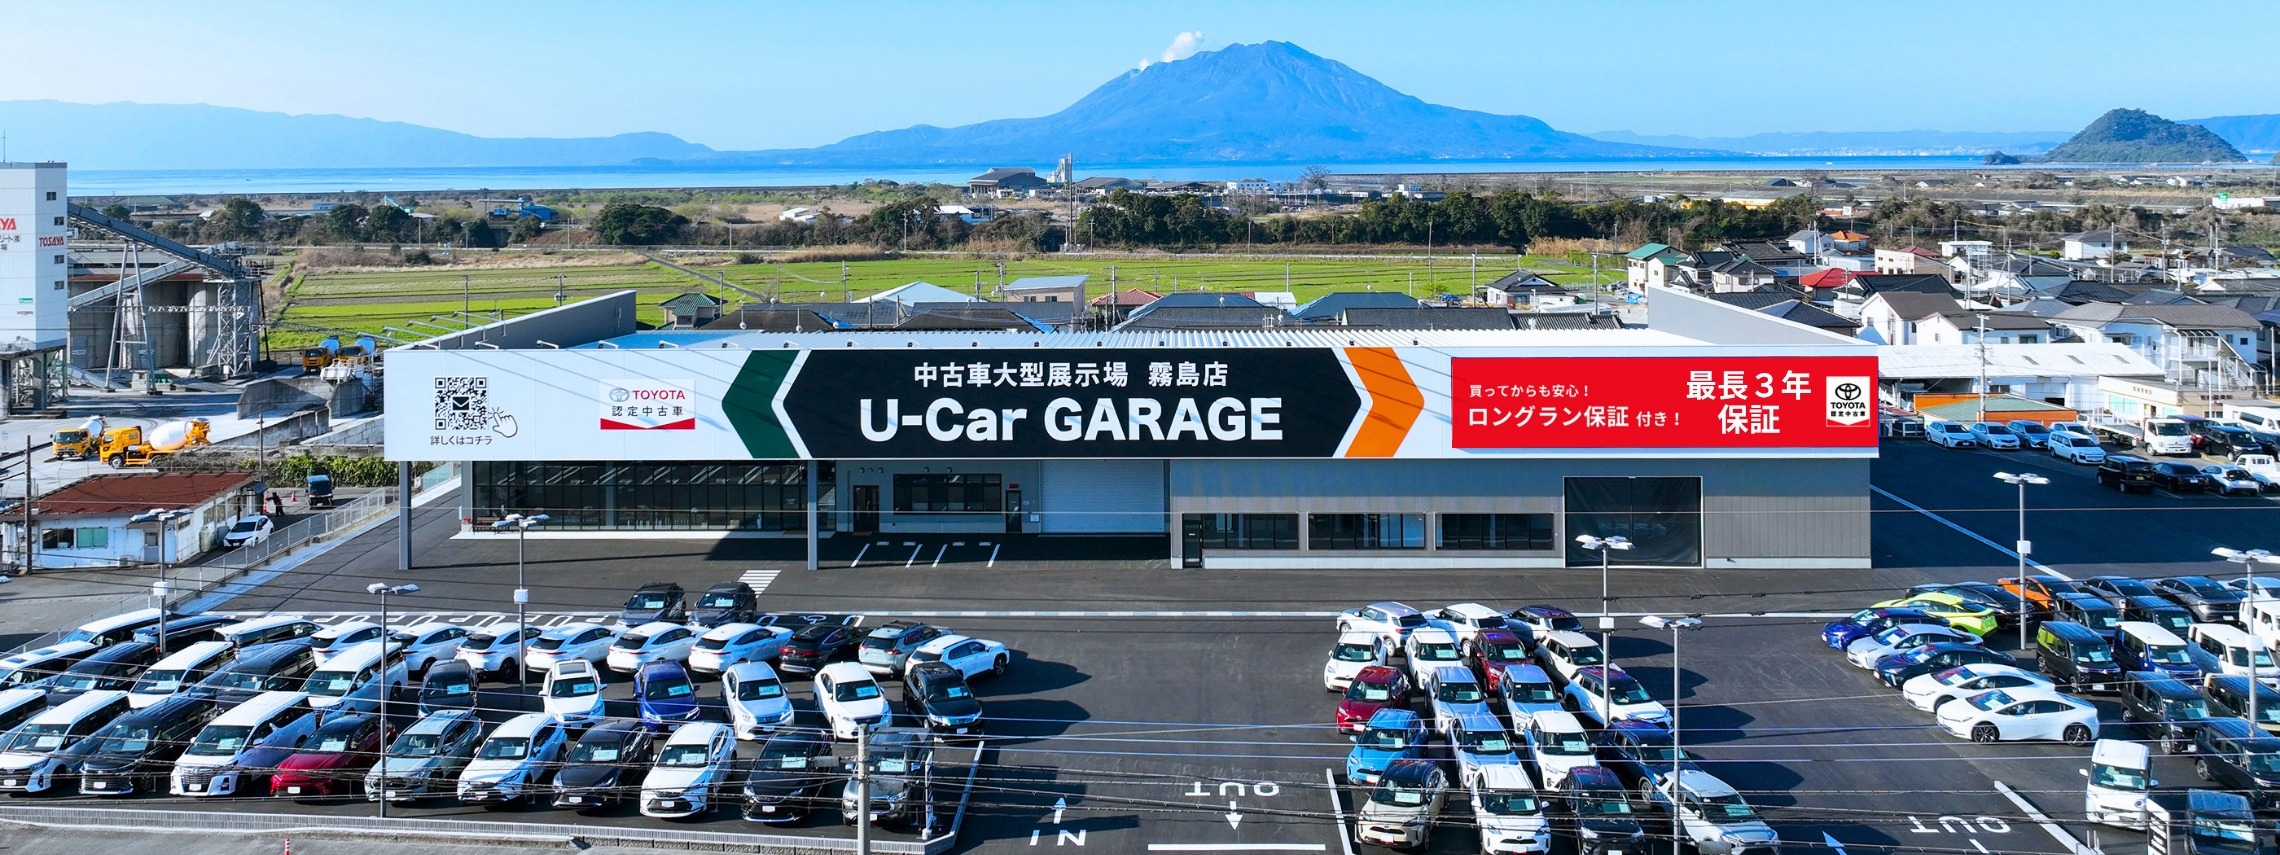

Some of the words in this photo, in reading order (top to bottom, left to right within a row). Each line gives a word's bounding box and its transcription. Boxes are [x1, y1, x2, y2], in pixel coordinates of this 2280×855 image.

[39, 236, 64, 247] TOSAYA
[914, 361, 1128, 388] 中古車大型展示場
[1148, 361, 1228, 387] 霧島店
[632, 390, 685, 400] TOYOTA
[1469, 384, 1589, 398] 買ってからも安心！
[611, 406, 683, 417] 認定中古車
[1830, 402, 1866, 410] TOYOTA
[860, 397, 1028, 442] U-Car
[1044, 397, 1283, 442] GARAGE
[1469, 405, 1629, 428] ロングラン保証
[1636, 411, 1680, 427] 付き！
[1717, 403, 1780, 435] 保証
[430, 435, 493, 446] 詳しくはコチラ
[1184, 782, 1280, 797] OUT
[1907, 815, 2011, 834] OUT
[1029, 829, 1087, 847] IN
